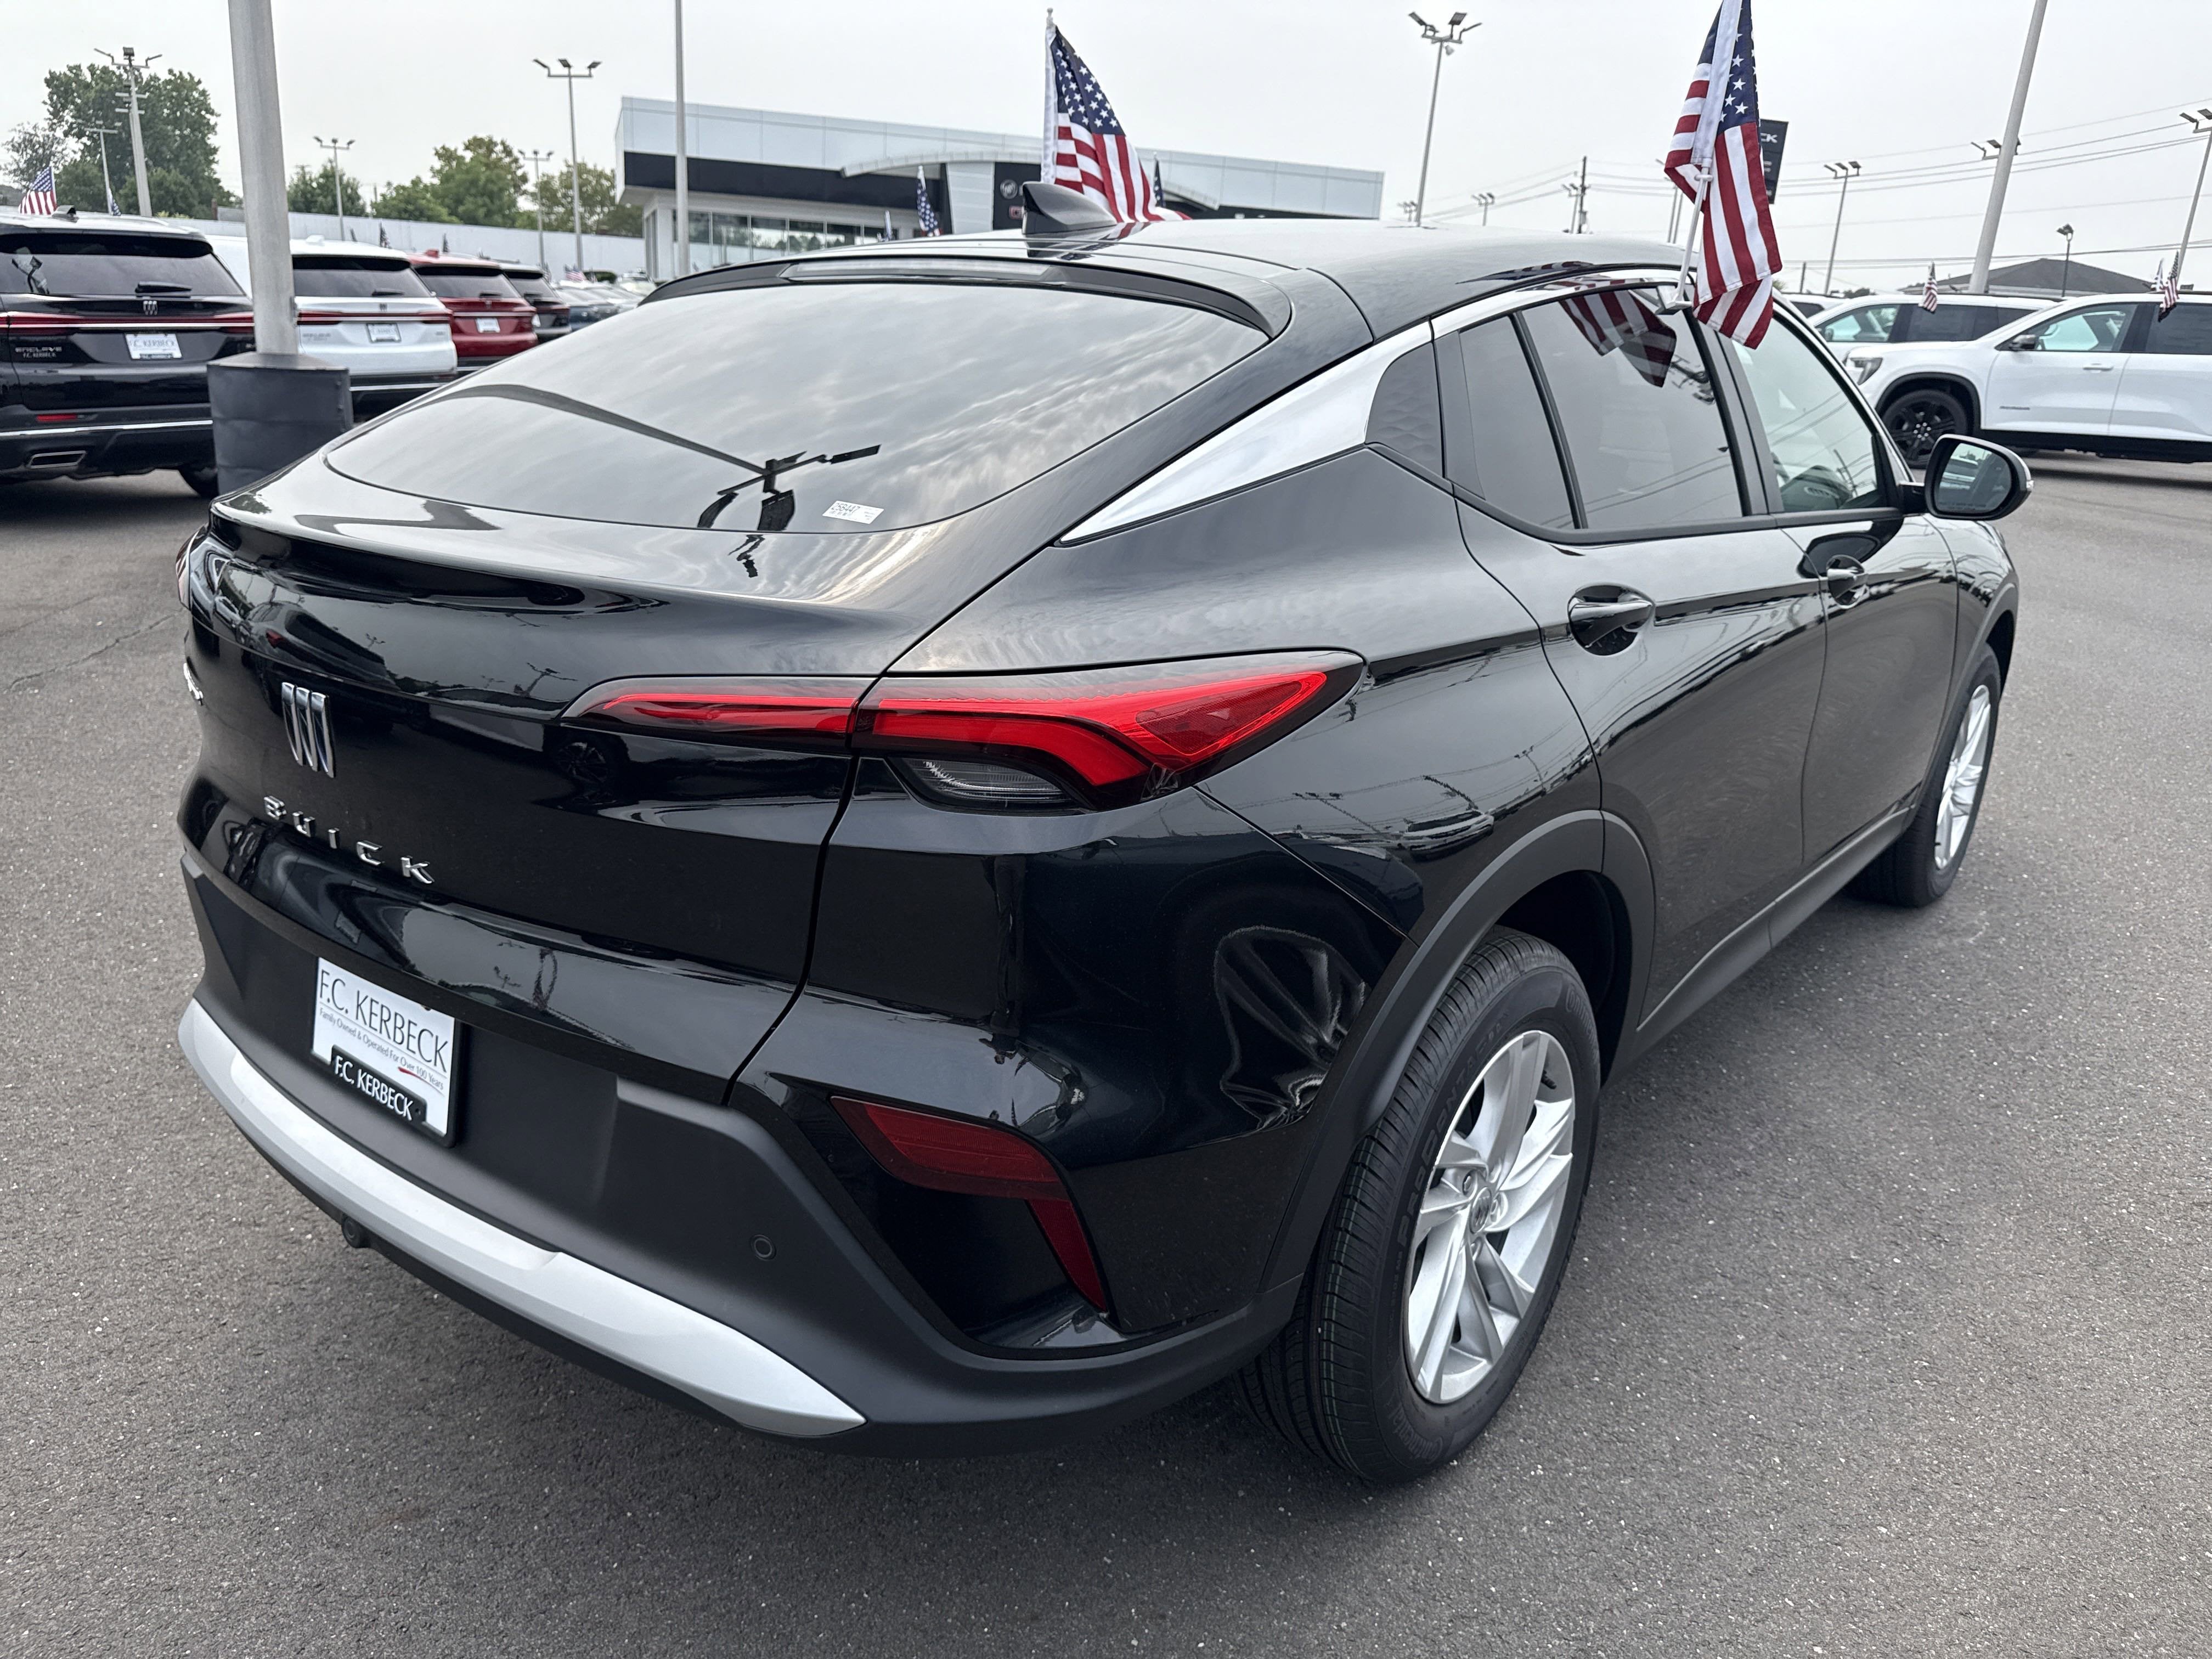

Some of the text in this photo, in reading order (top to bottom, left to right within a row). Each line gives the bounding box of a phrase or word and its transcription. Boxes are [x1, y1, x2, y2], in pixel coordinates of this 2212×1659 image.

[263, 795, 435, 884] BUICK
[320, 969, 448, 1073] F.C. KERBECK
[320, 1007, 336, 1026] Family
[337, 1018, 357, 1037] Owned
[363, 1034, 389, 1057] Operated
[390, 1049, 399, 1062] For
[400, 1057, 415, 1071] Over
[416, 1066, 427, 1080] 100
[428, 1073, 444, 1091] Years
[334, 1055, 414, 1120] F.C. KERBECK
